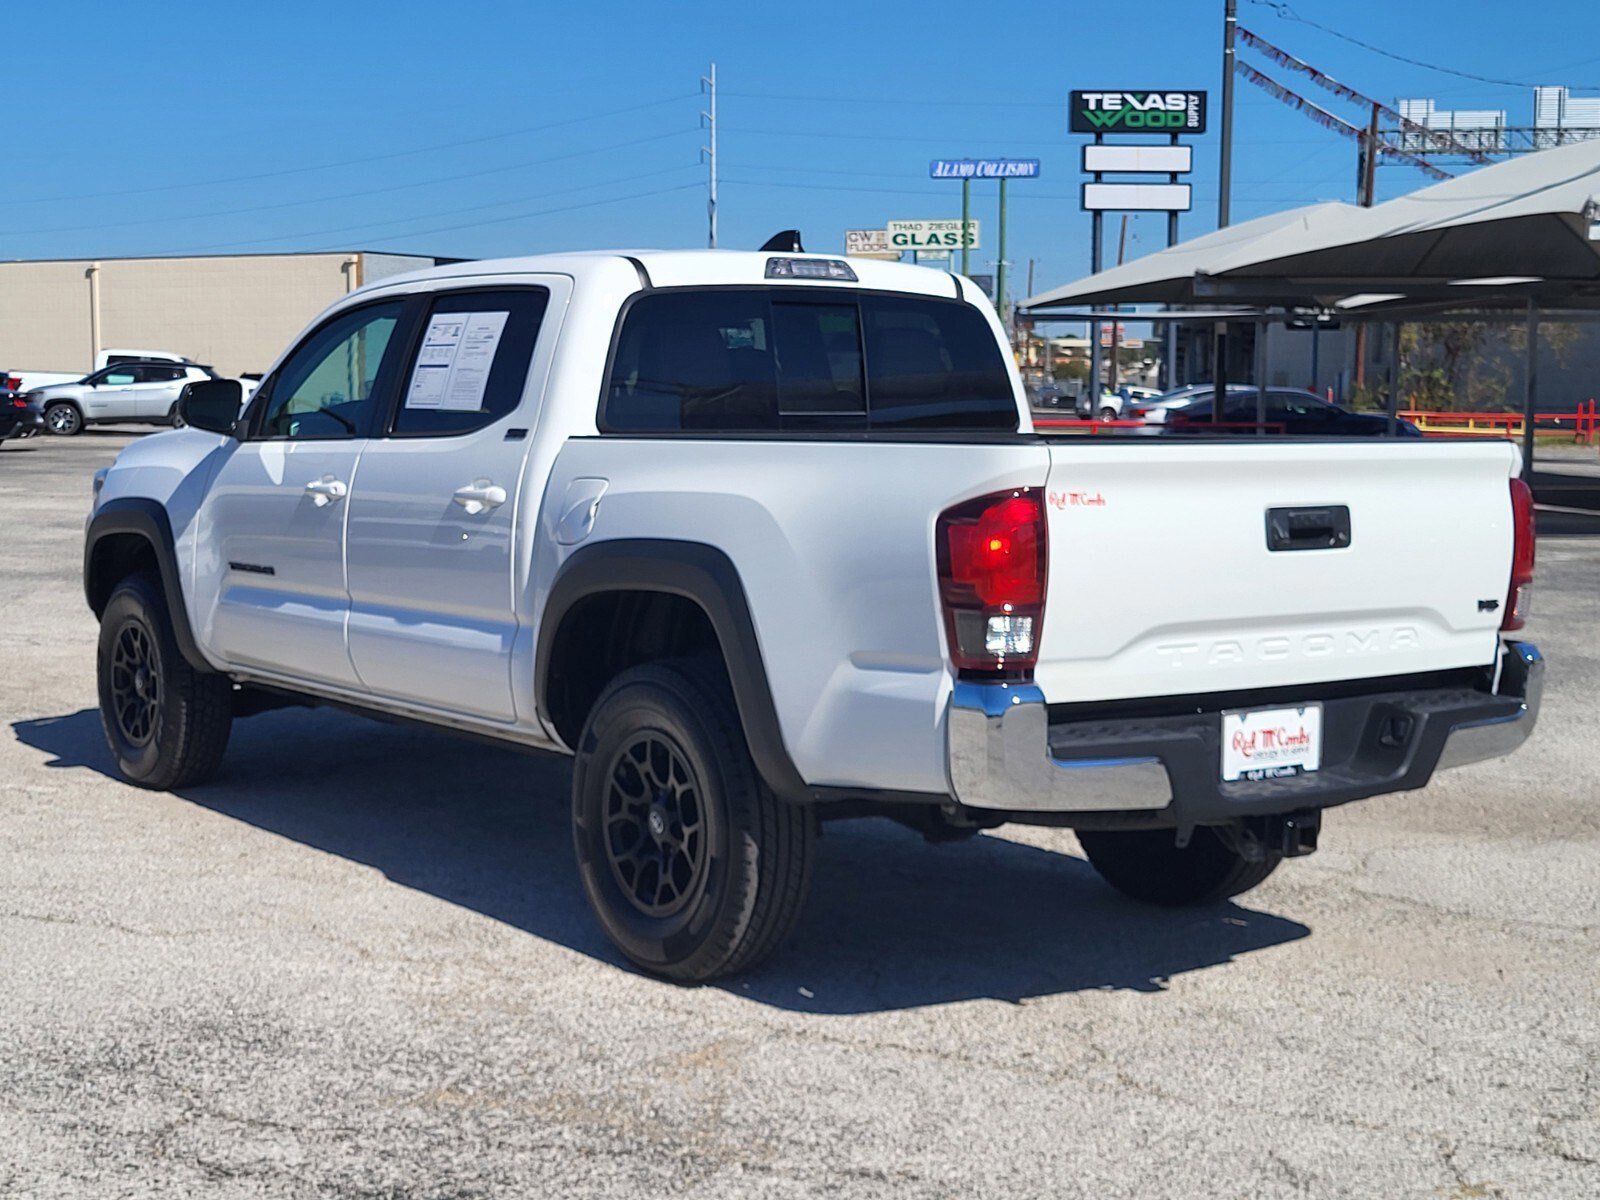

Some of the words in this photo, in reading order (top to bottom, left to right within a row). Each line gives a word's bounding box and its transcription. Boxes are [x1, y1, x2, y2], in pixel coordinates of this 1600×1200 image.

[1081, 93, 1187, 111] TEXAS
[1187, 93, 1200, 128] SUPPLY
[1081, 106, 1187, 128] WOOD
[892, 223, 923, 232] THAD
[891, 233, 975, 246] GLASS
[1156, 626, 1420, 668] TACOMA
[1233, 729, 1256, 757] Red
